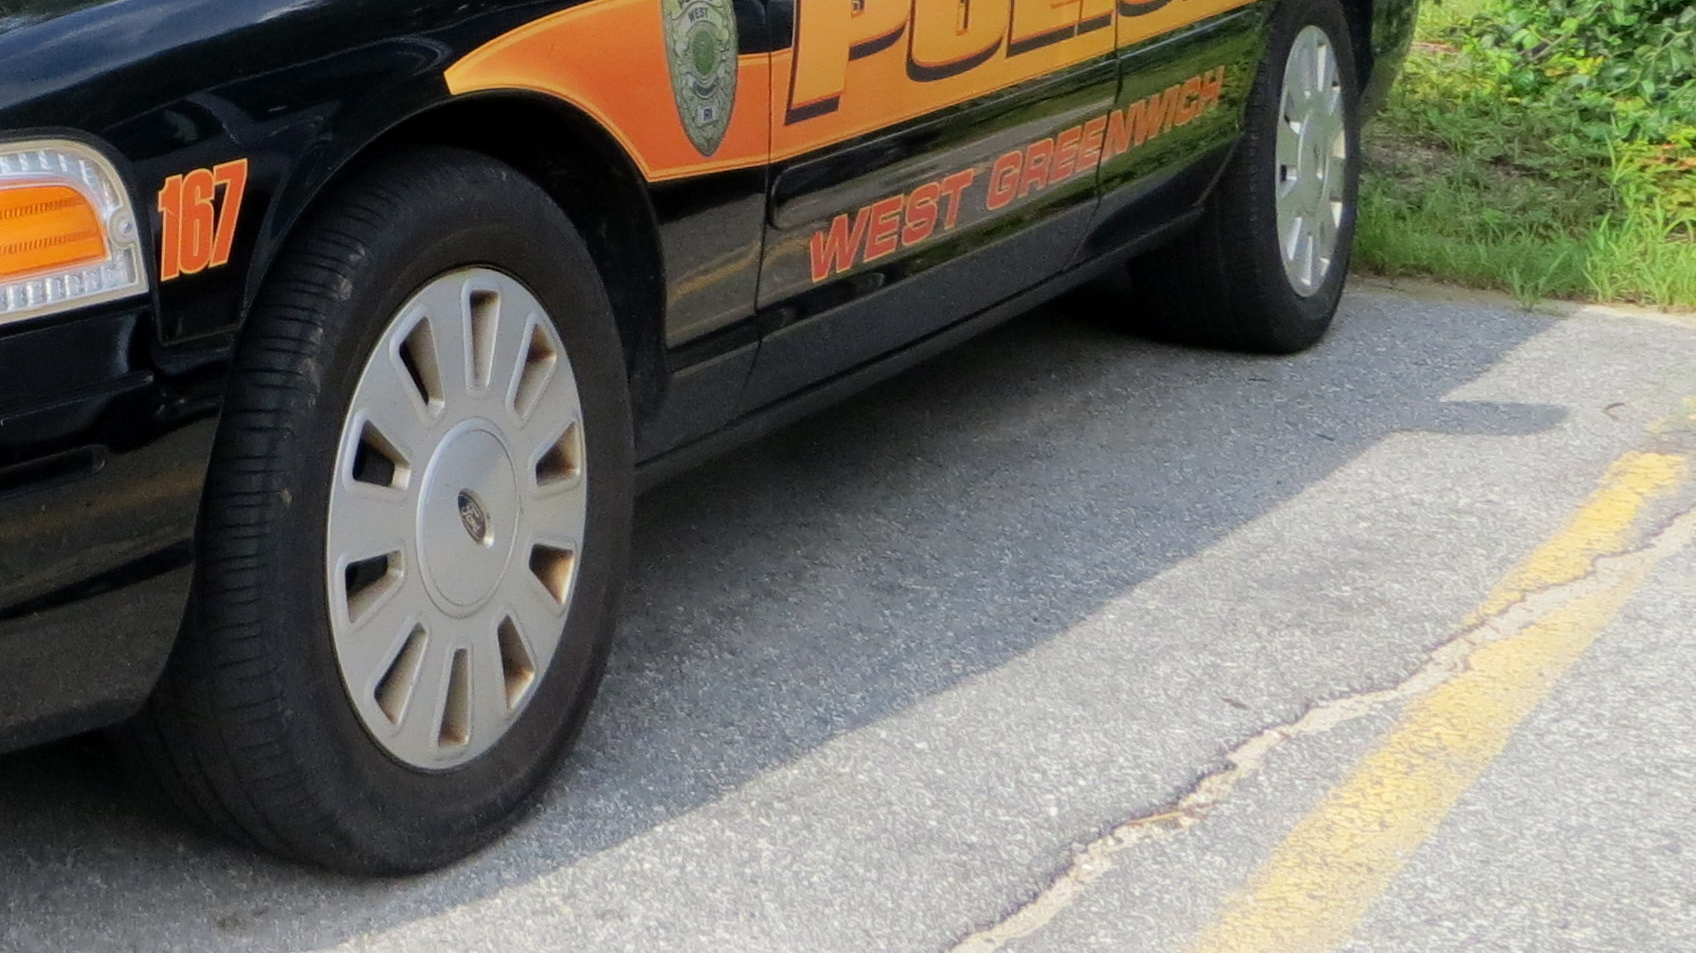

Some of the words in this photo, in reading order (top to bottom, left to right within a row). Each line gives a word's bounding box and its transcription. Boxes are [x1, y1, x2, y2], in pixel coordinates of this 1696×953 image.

[158, 158, 248, 282] 167
[807, 168, 974, 283] WEST
[987, 66, 1225, 212] GREENWICH
